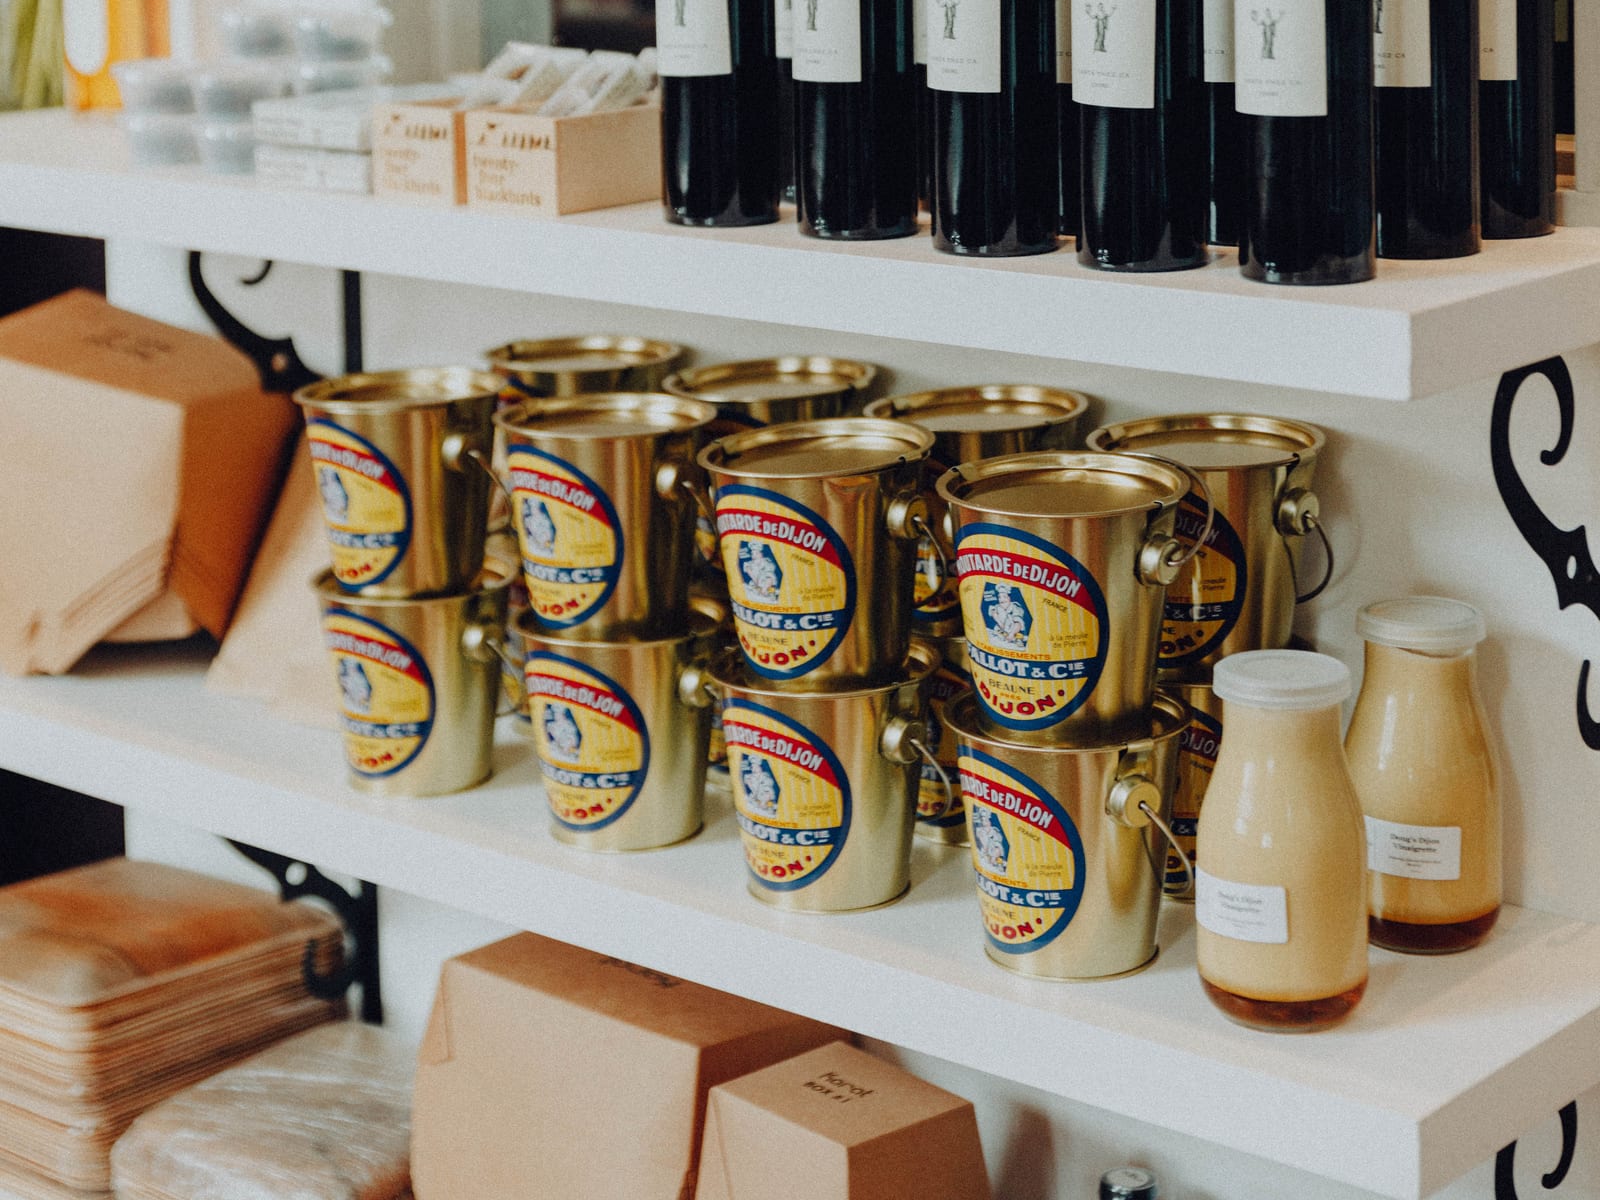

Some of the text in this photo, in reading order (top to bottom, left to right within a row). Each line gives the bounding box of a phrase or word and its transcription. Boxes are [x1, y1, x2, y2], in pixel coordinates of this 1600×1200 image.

[550, 479, 596, 511] DIJON
[763, 521, 778, 536] DE
[778, 521, 828, 553] DIJON
[1013, 563, 1030, 578] DE
[1030, 564, 1082, 598] DIJON
[1043, 597, 1069, 614] FRANCE
[784, 618, 798, 630] &
[741, 634, 809, 665] DIJON
[988, 678, 1035, 696] BEAUNE
[1031, 666, 1046, 679] &
[577, 686, 624, 718] DIJON
[979, 680, 1057, 716] DIJON
[776, 738, 825, 771] DIJON
[991, 788, 1006, 805] DE
[1005, 792, 1055, 829] DIJON
[781, 832, 795, 845] &
[975, 871, 1010, 902] LLOT
[1011, 892, 1025, 905] &
[803, 1081, 834, 1095] BOX
